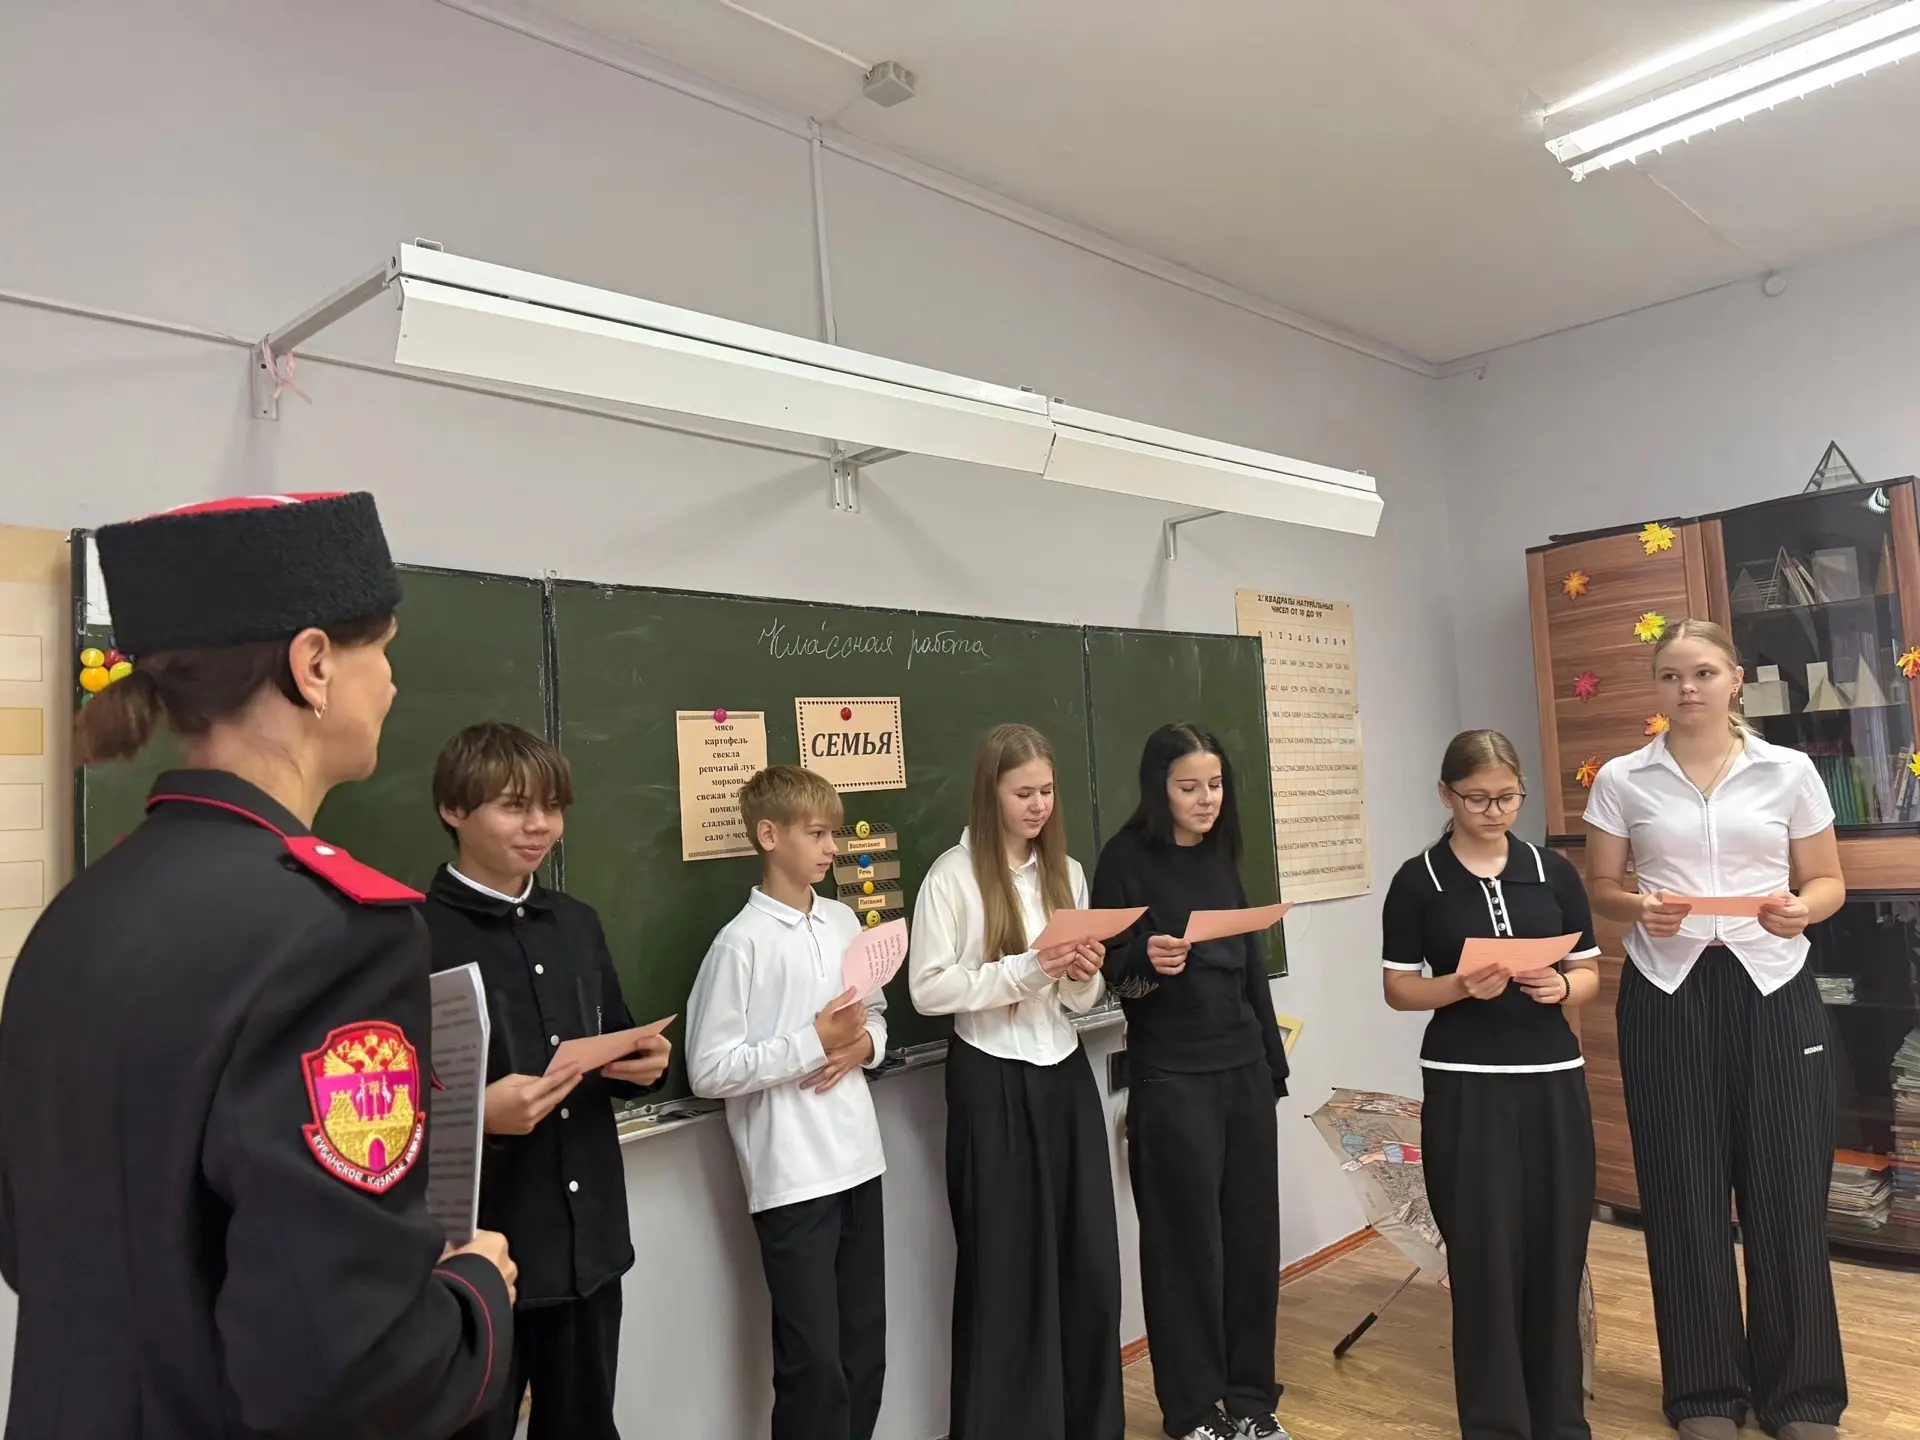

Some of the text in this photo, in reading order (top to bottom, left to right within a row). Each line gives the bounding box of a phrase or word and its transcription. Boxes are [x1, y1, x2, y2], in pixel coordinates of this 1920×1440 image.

[1264, 595, 1295, 605] КВАДРАТЫ
[1296, 599, 1334, 611] НАТУРАЛЬНЫХ
[1271, 605, 1289, 614] ЧИСЕЛ
[1290, 608, 1298, 616] ОТ
[1306, 610, 1315, 618] ДО
[907, 629, 990, 670] работа
[704, 736, 748, 747] картофель
[811, 731, 893, 757] СЕМЬЯ
[698, 763, 756, 775] репчатый лук
[696, 792, 726, 801] свежая
[709, 805, 740, 814] помидо
[701, 817, 736, 828] сладкий
[704, 834, 724, 842] сало
[849, 841, 881, 849] Воспитание
[312, 1134, 364, 1182] КУБАНСКОЕ
